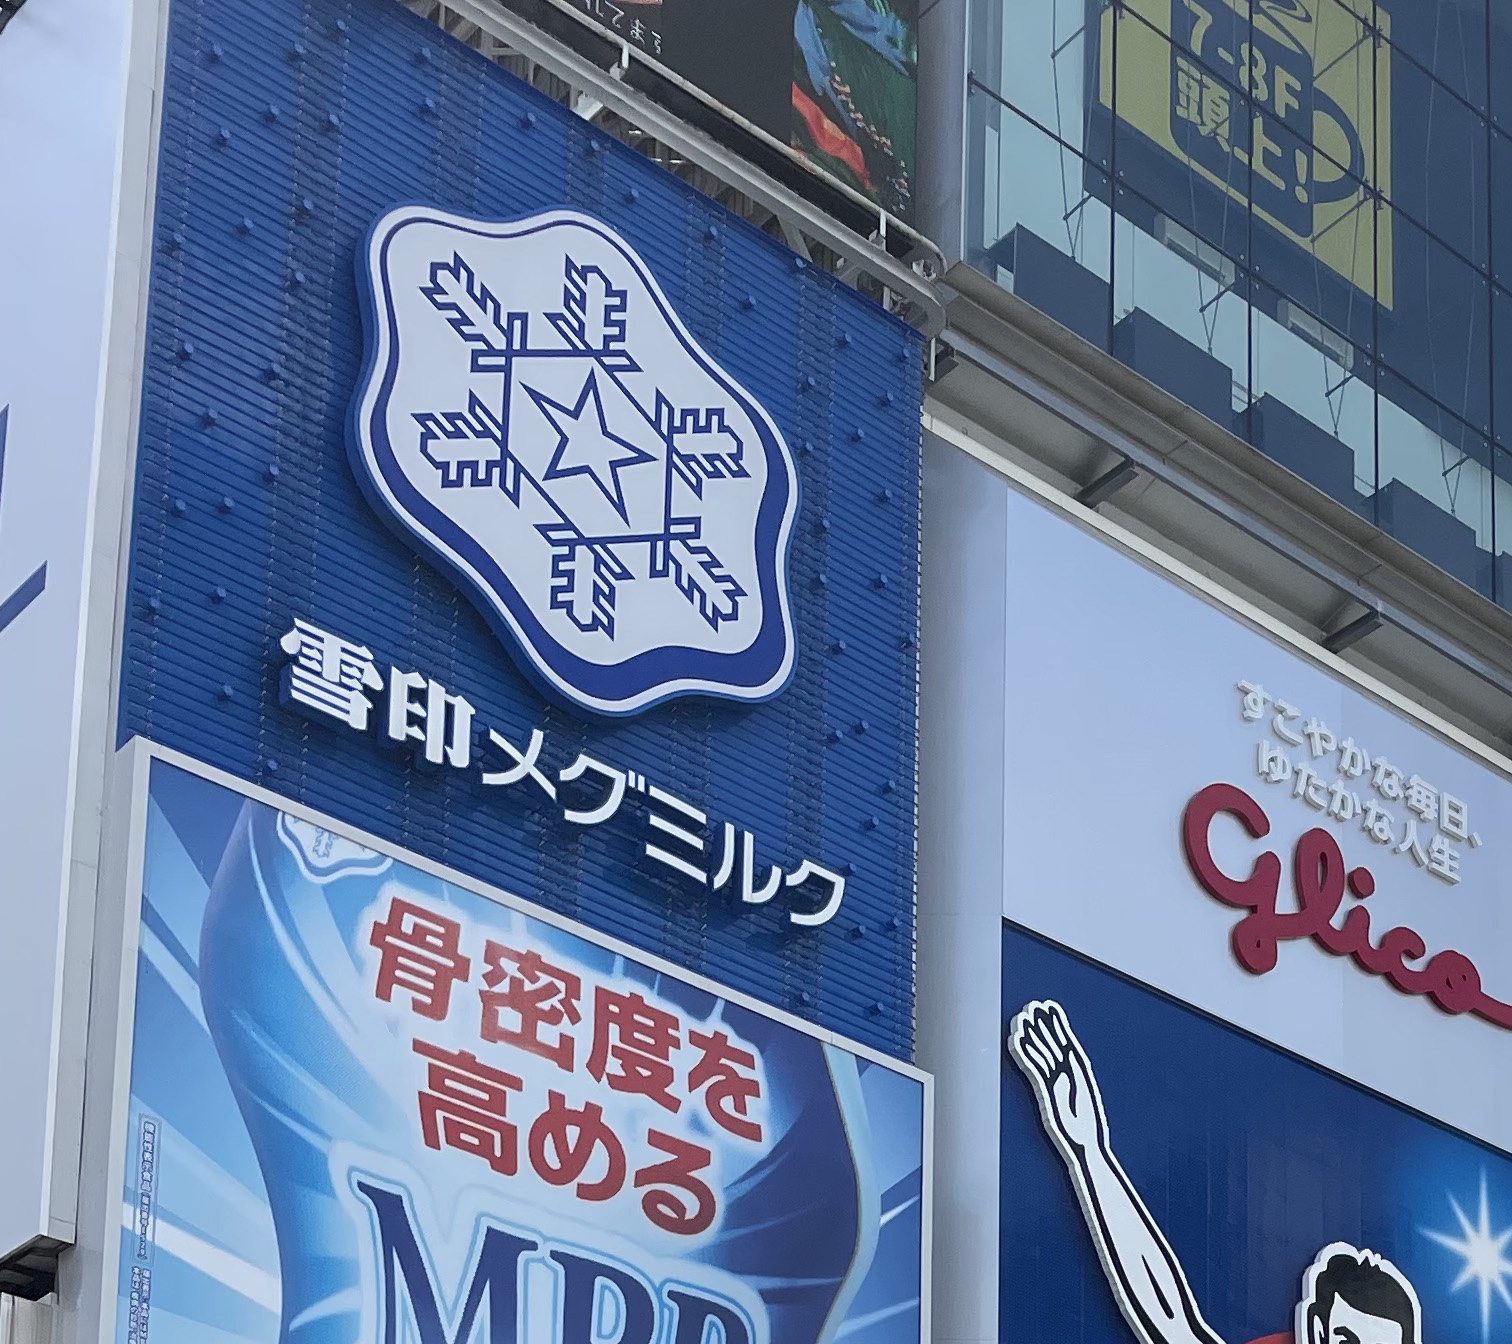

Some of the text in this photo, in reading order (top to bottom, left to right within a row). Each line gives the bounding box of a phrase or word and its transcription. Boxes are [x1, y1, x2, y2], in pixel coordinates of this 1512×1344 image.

[280, 617, 847, 928] 雪印メグミルク
[1236, 679, 1484, 849] すこやかな毎日、
[1257, 741, 1462, 885] ゆたかな人生
[367, 895, 765, 1144] 骨密度を
[411, 1038, 718, 1237] 高める
